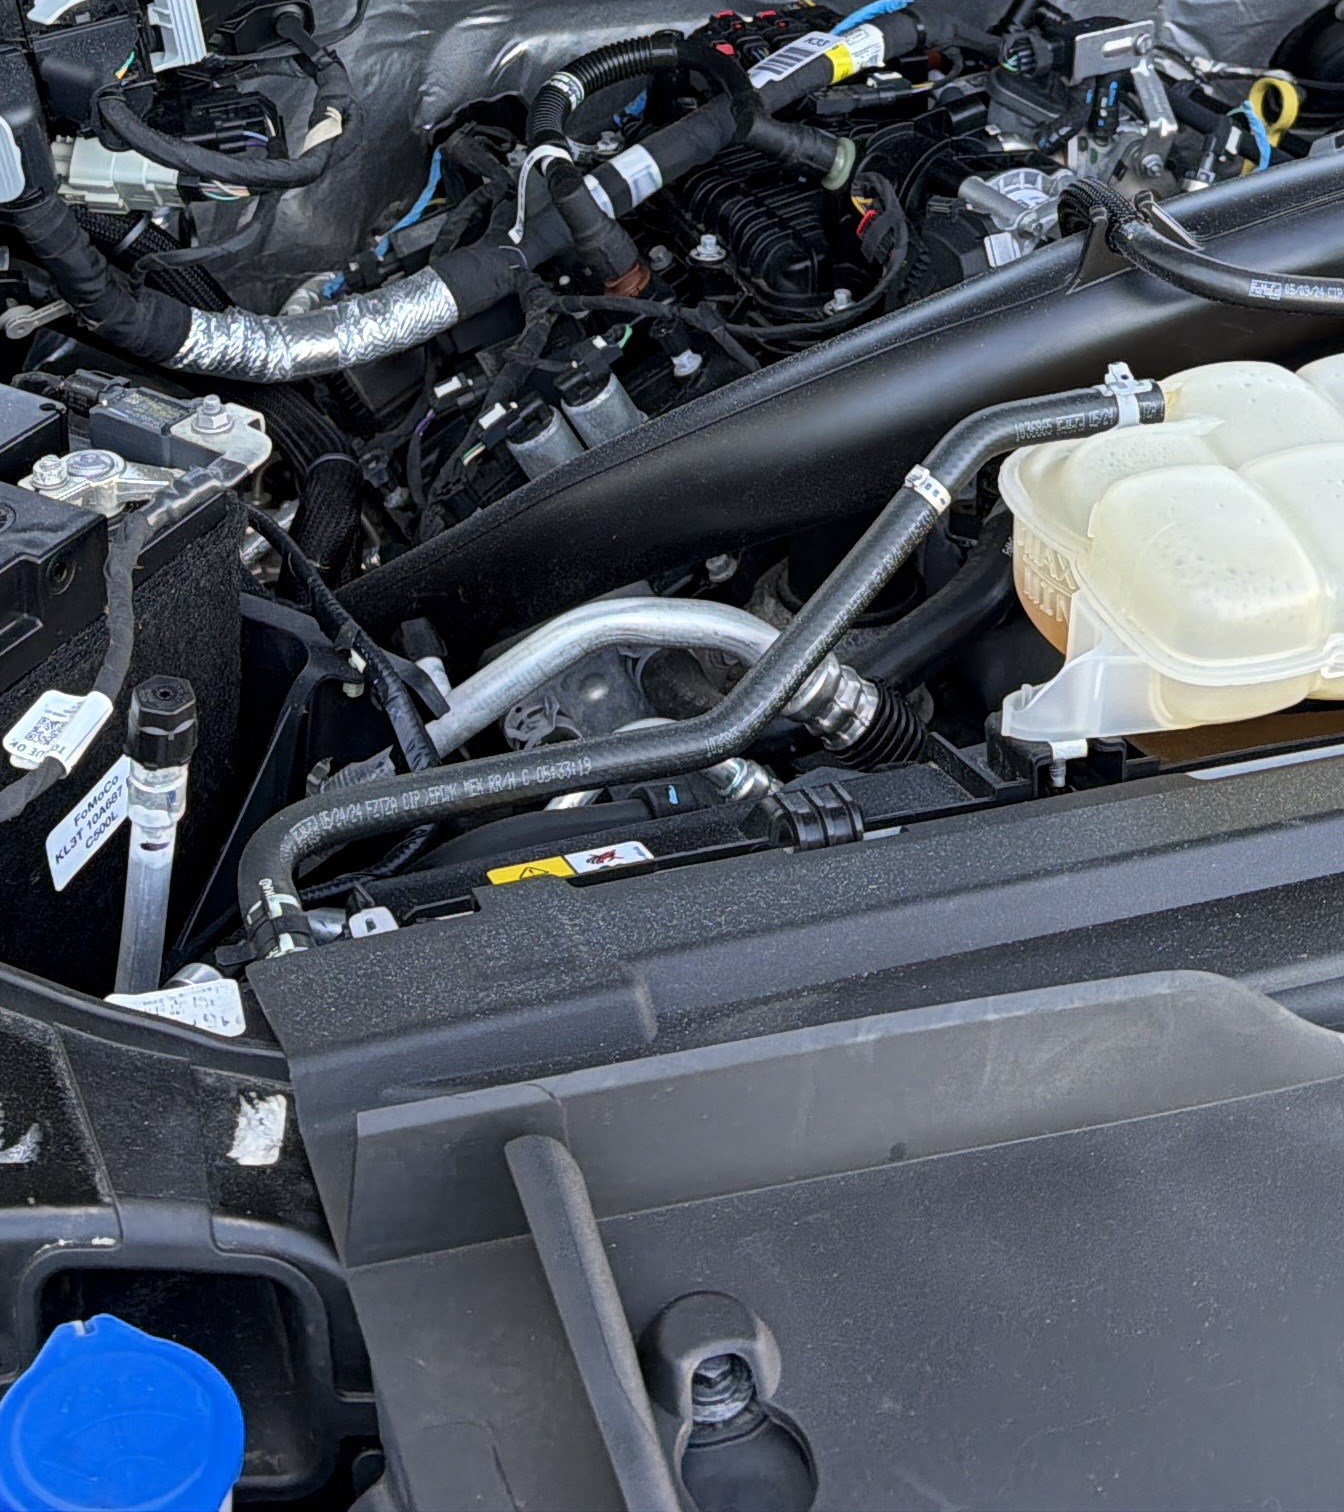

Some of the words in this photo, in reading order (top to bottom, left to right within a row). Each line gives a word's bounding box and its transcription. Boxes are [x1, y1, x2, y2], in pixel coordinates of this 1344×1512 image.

[73, 775, 119, 827] FoMoCo
[54, 827, 84, 865] KL3T
[85, 810, 119, 849] C500L
